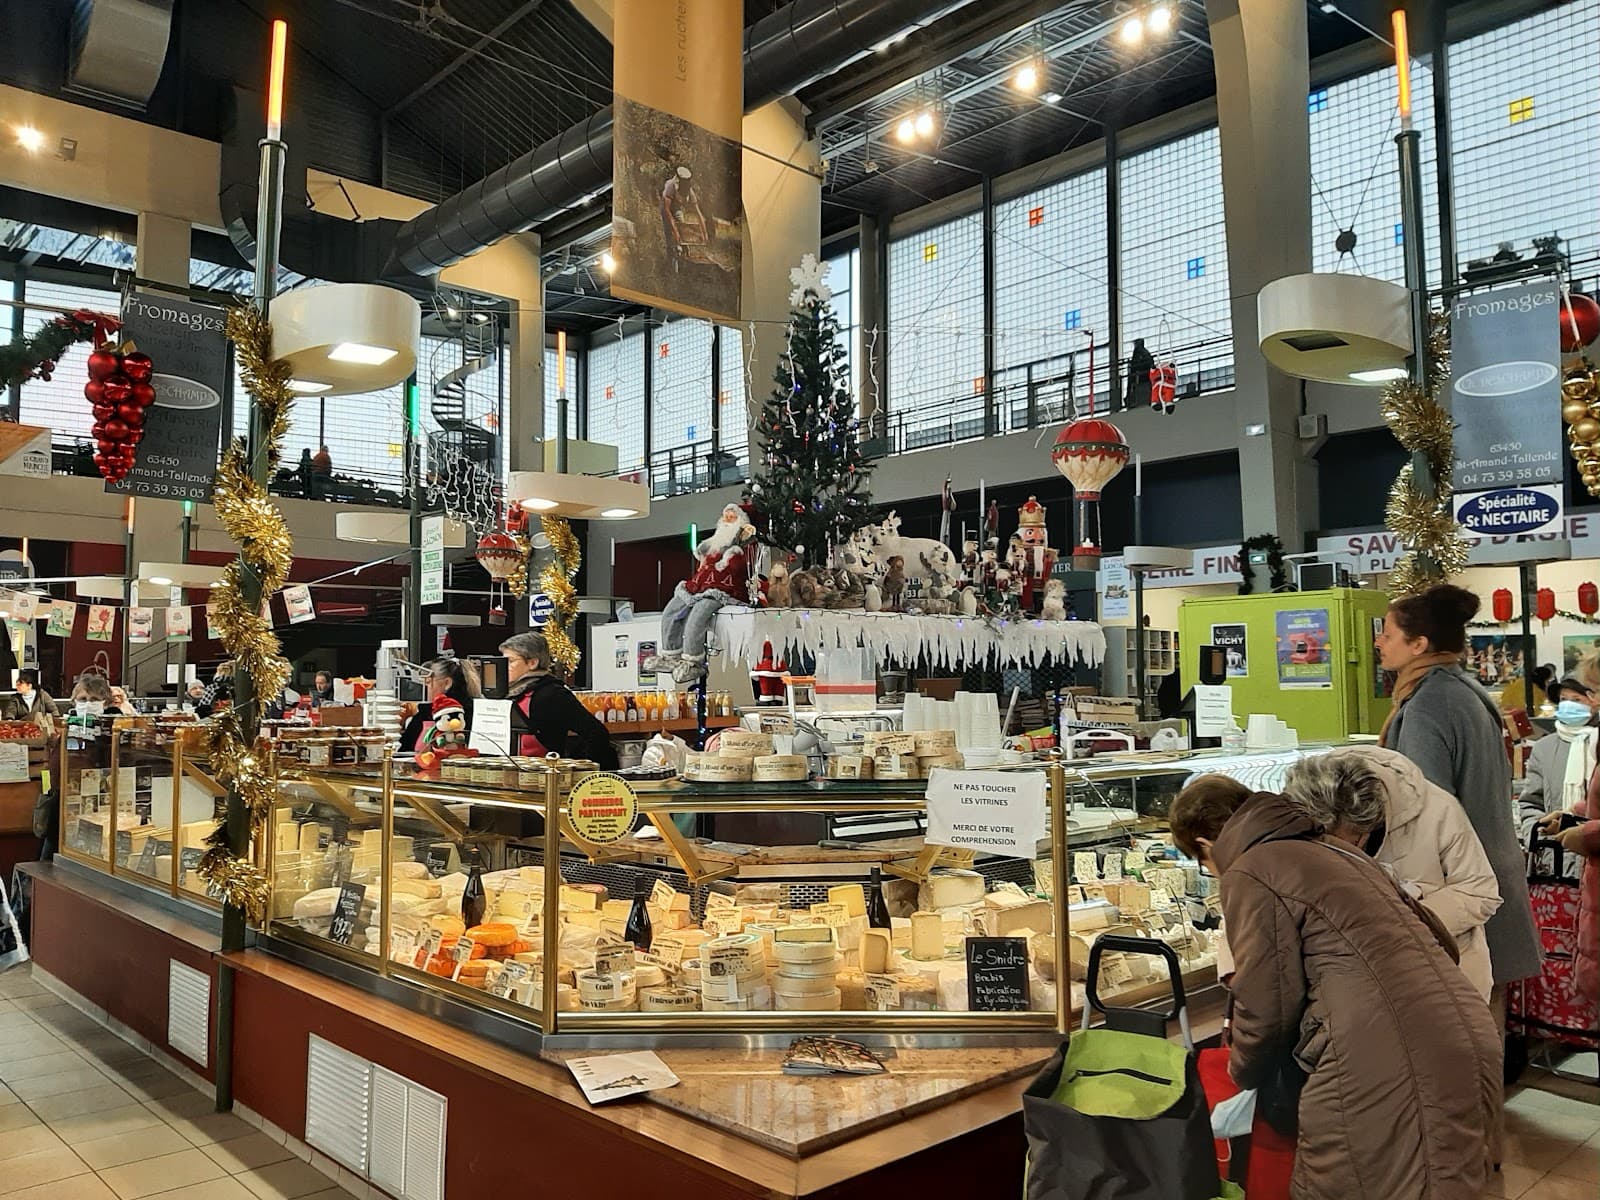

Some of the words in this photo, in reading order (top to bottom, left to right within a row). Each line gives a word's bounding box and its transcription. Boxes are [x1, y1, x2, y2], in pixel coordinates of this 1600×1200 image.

[126, 293, 225, 332] Fromages
[1454, 290, 1556, 320] Fromages
[147, 455, 180, 467] 63450
[1462, 474, 1477, 484] 04
[1481, 472, 1496, 483] 73
[1499, 470, 1514, 481] 39
[1516, 468, 1532, 479] 38
[1535, 466, 1551, 476] 05
[136, 481, 150, 492] 73
[153, 483, 168, 495] 39
[171, 485, 186, 497] 38
[190, 488, 205, 498] 05
[1478, 492, 1537, 513] Spécialité
[1465, 514, 1480, 528] St
[1482, 508, 1550, 527] NECTAIRE
[1203, 555, 1243, 575] FIN
[1214, 637, 1244, 645] VICHY
[953, 783, 963, 791] NE
[965, 784, 980, 792] PAS
[982, 785, 1017, 793] TOUCHER
[960, 797, 973, 805] LES
[974, 798, 1009, 807] VITRINES
[952, 823, 977, 832] MERCI
[978, 825, 988, 833] DE
[989, 825, 1015, 834] VOTRE
[950, 835, 1017, 846] COMPREHENSION
[970, 943, 983, 964] Le
